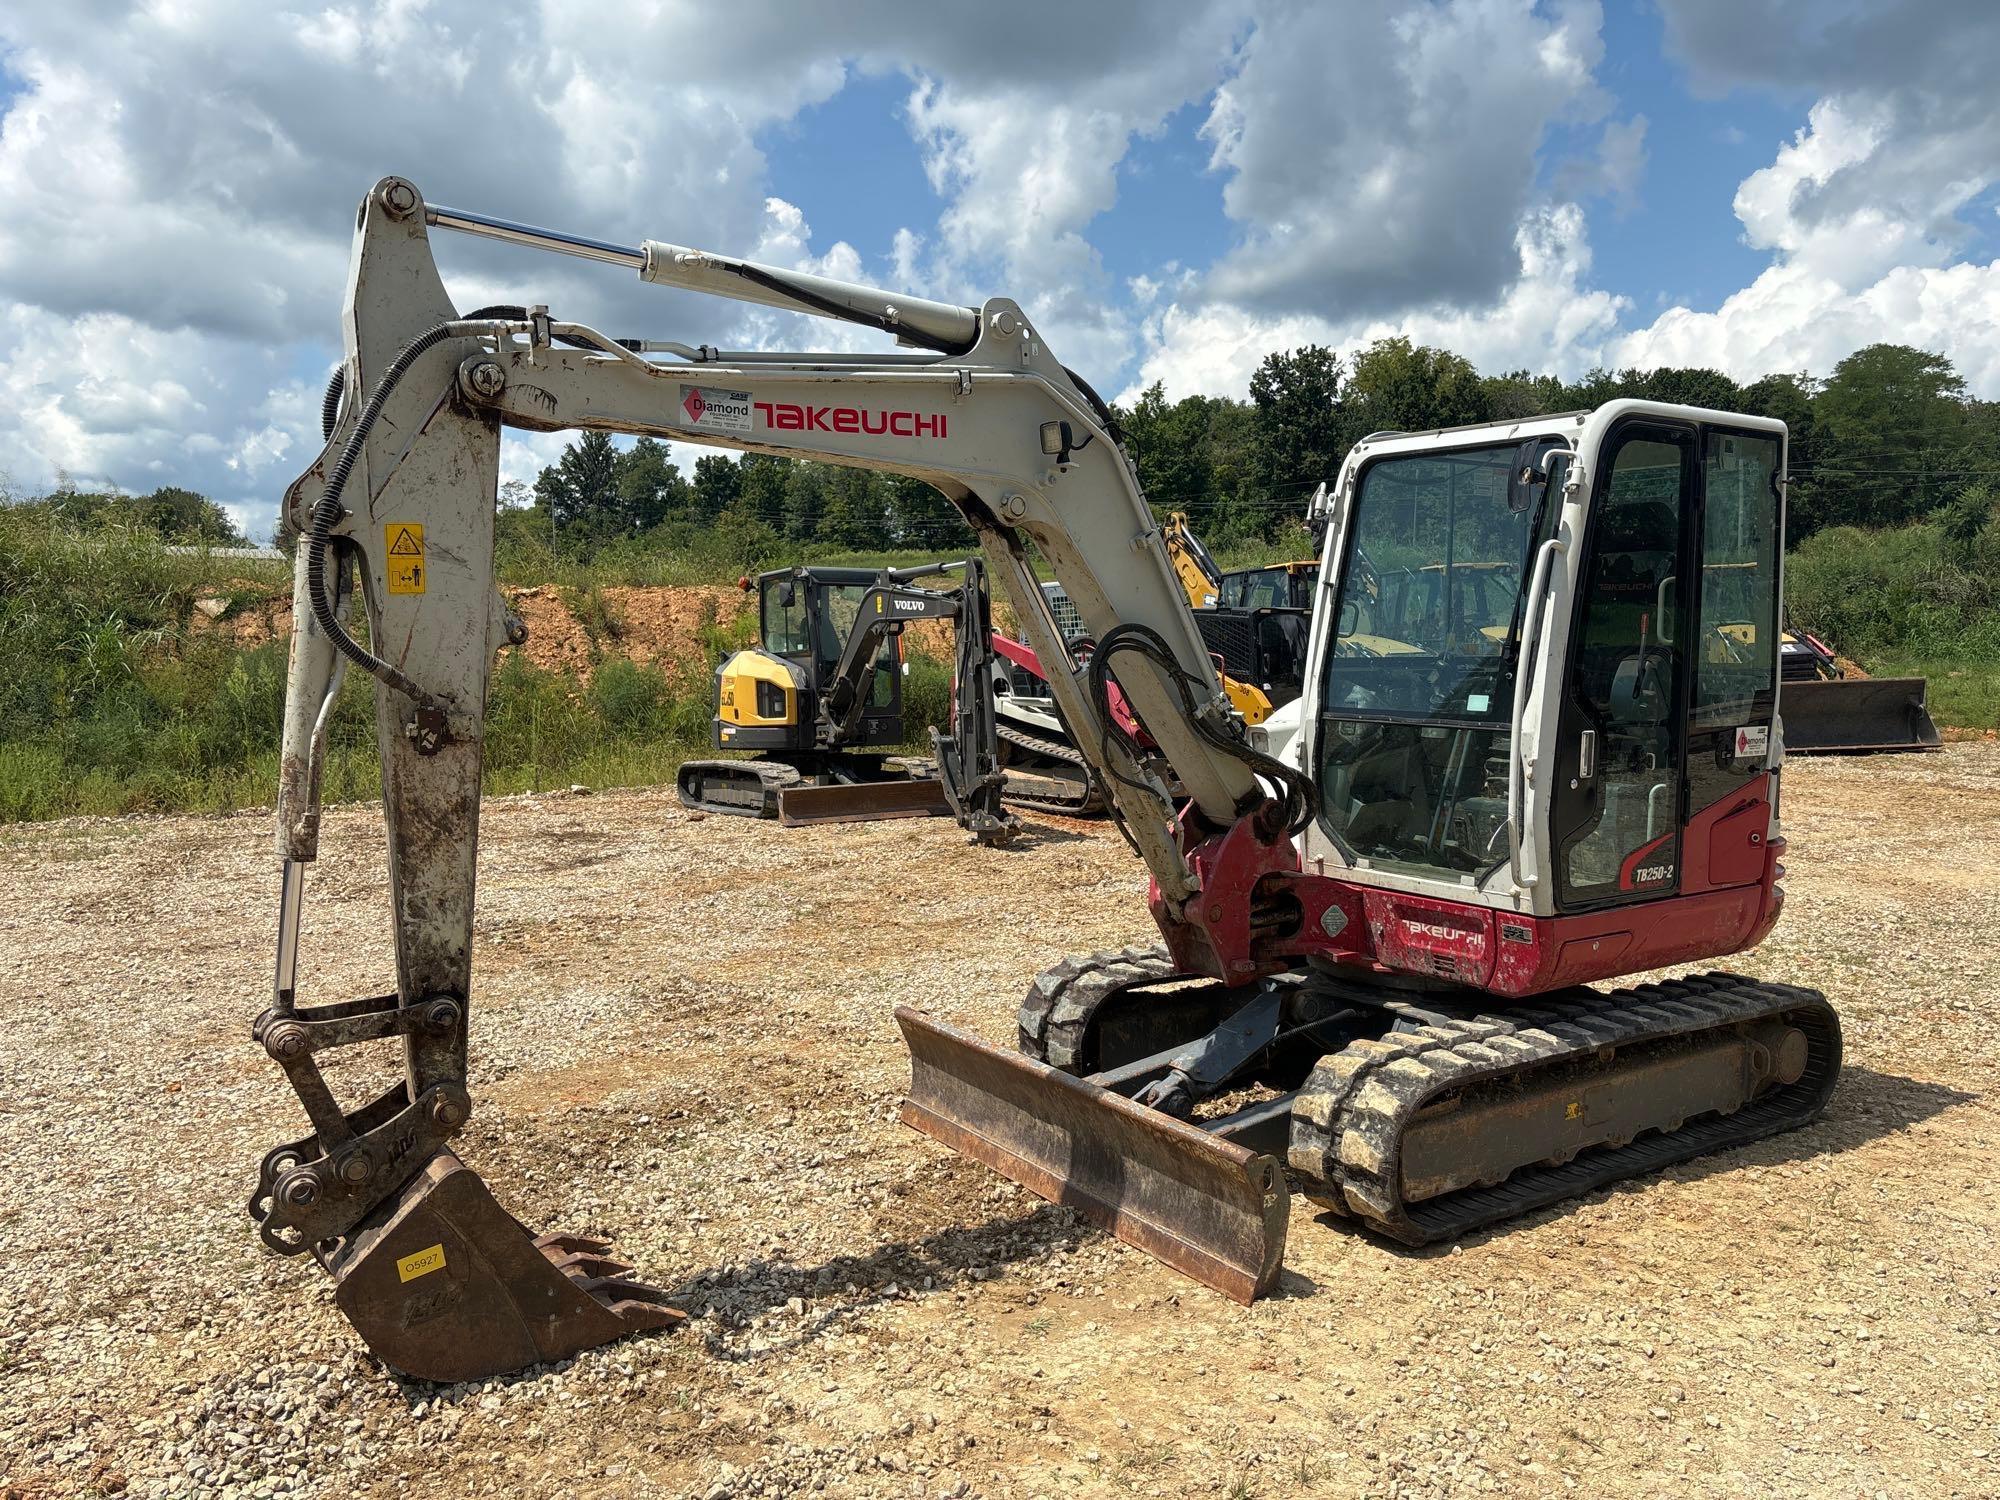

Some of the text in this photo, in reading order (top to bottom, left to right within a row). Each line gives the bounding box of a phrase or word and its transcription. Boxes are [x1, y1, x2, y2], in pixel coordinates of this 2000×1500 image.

[693, 399, 749, 416] Diamond
[894, 600, 925, 611] VOLVO
[1636, 865, 1674, 882] TB250-2
